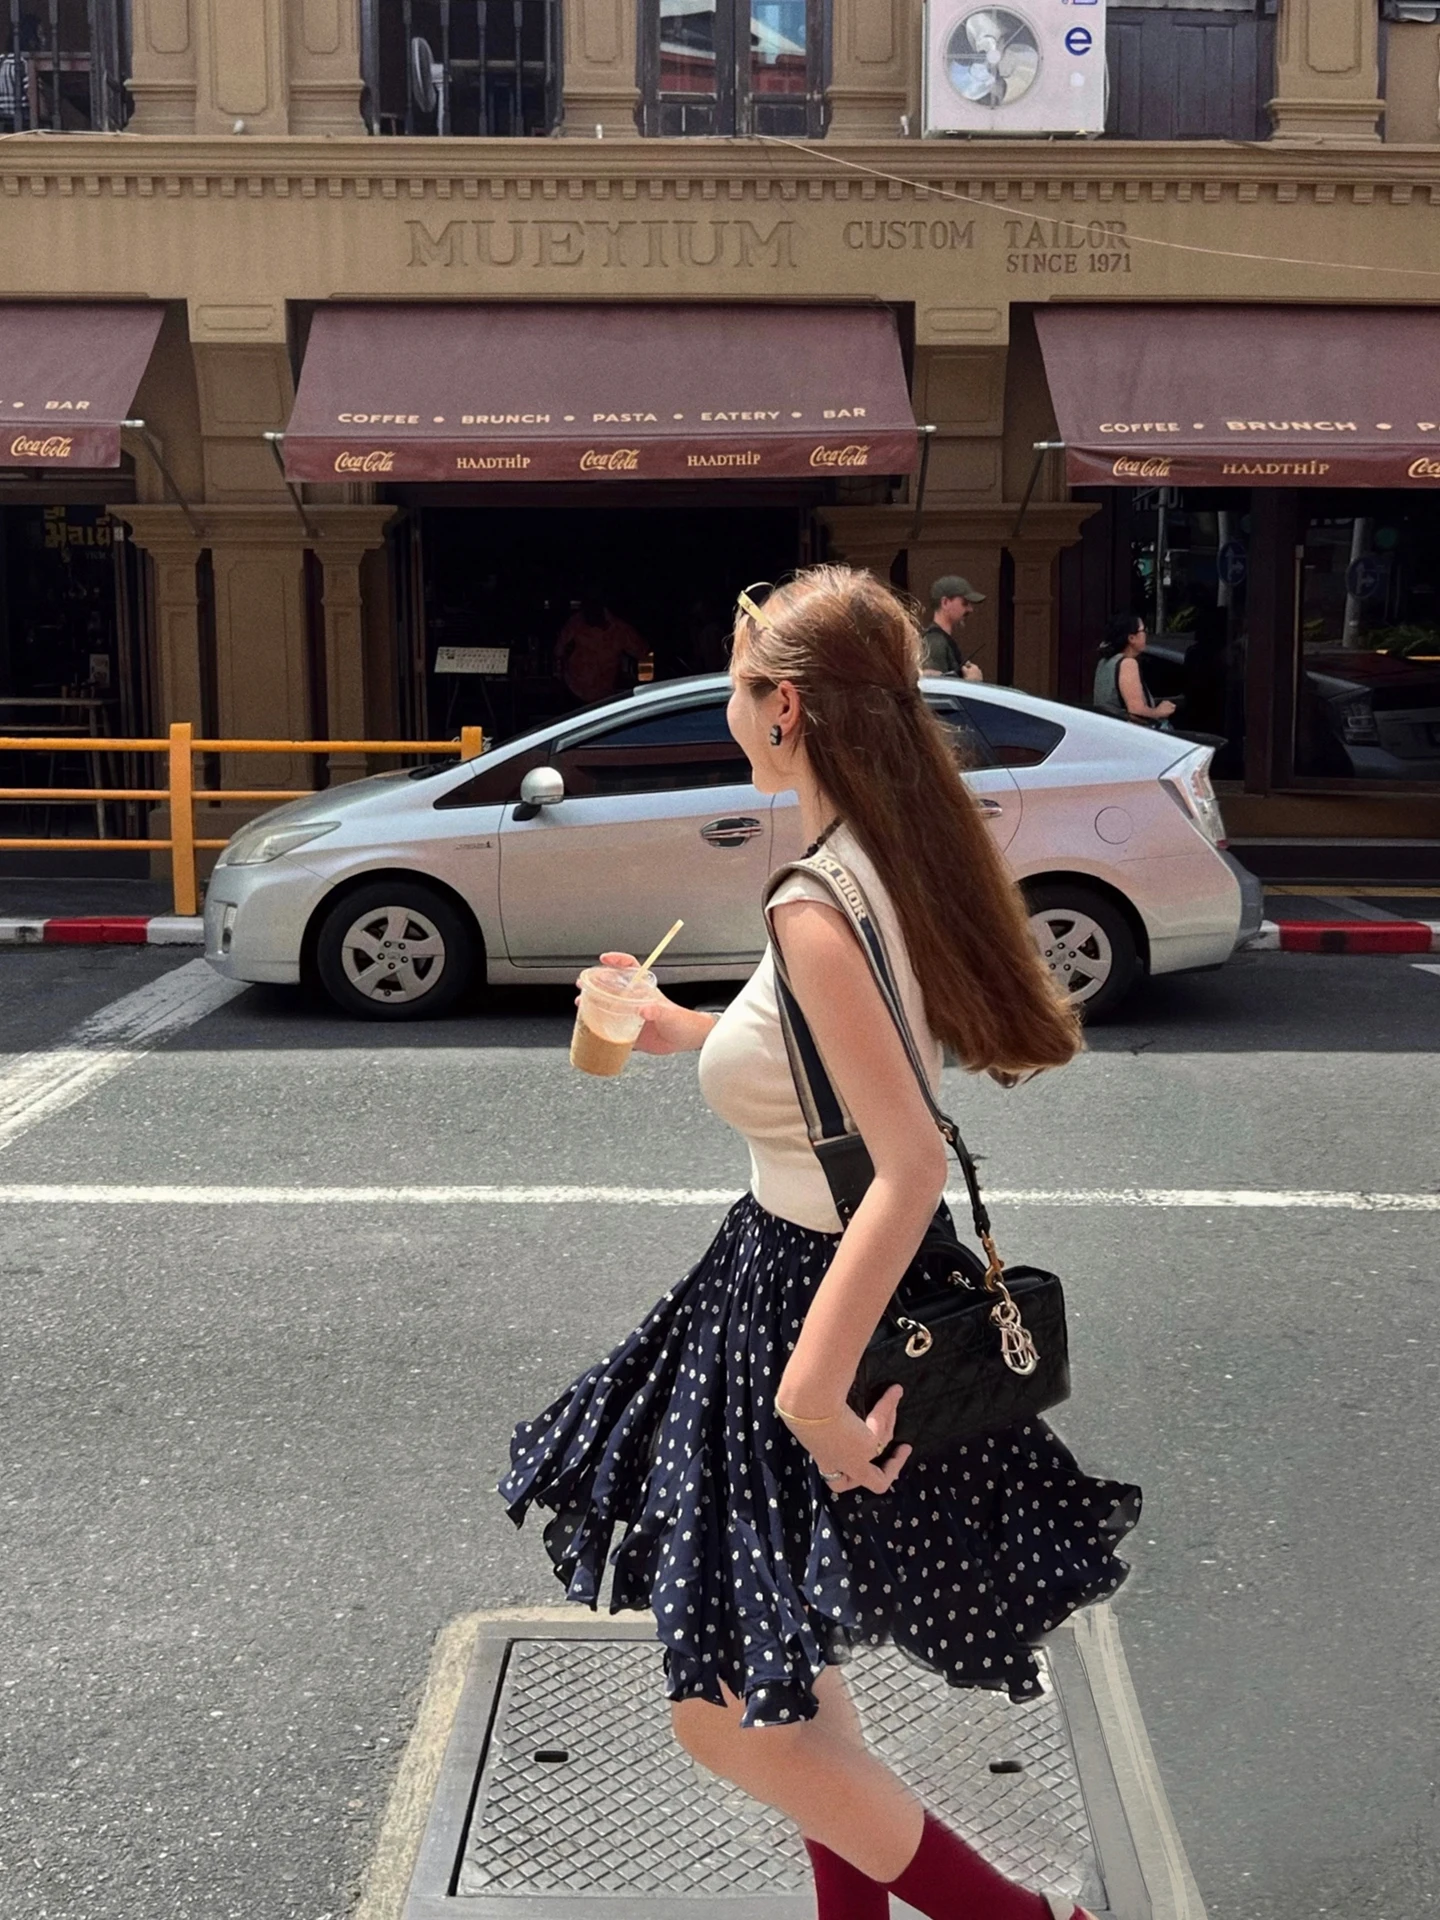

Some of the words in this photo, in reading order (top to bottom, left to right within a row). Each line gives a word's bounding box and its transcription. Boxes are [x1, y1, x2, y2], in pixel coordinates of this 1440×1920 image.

[1065, 27, 1092, 56] e
[404, 220, 798, 268] MUEYIUM
[842, 220, 975, 250] CUSTOM
[1003, 220, 1132, 250] TAILOR
[1006, 253, 1078, 273] SINCE
[1088, 253, 1132, 273] 1971
[44, 400, 91, 410] BAR
[337, 412, 420, 425] COFFEE
[461, 413, 551, 425] BRUNCH
[592, 412, 658, 423] PASTA
[700, 410, 781, 422] EATERY
[822, 407, 866, 419] BAR
[1099, 422, 1181, 433] COFFEE
[1225, 420, 1358, 432] BRUNCH
[1416, 422, 1440, 431] P
